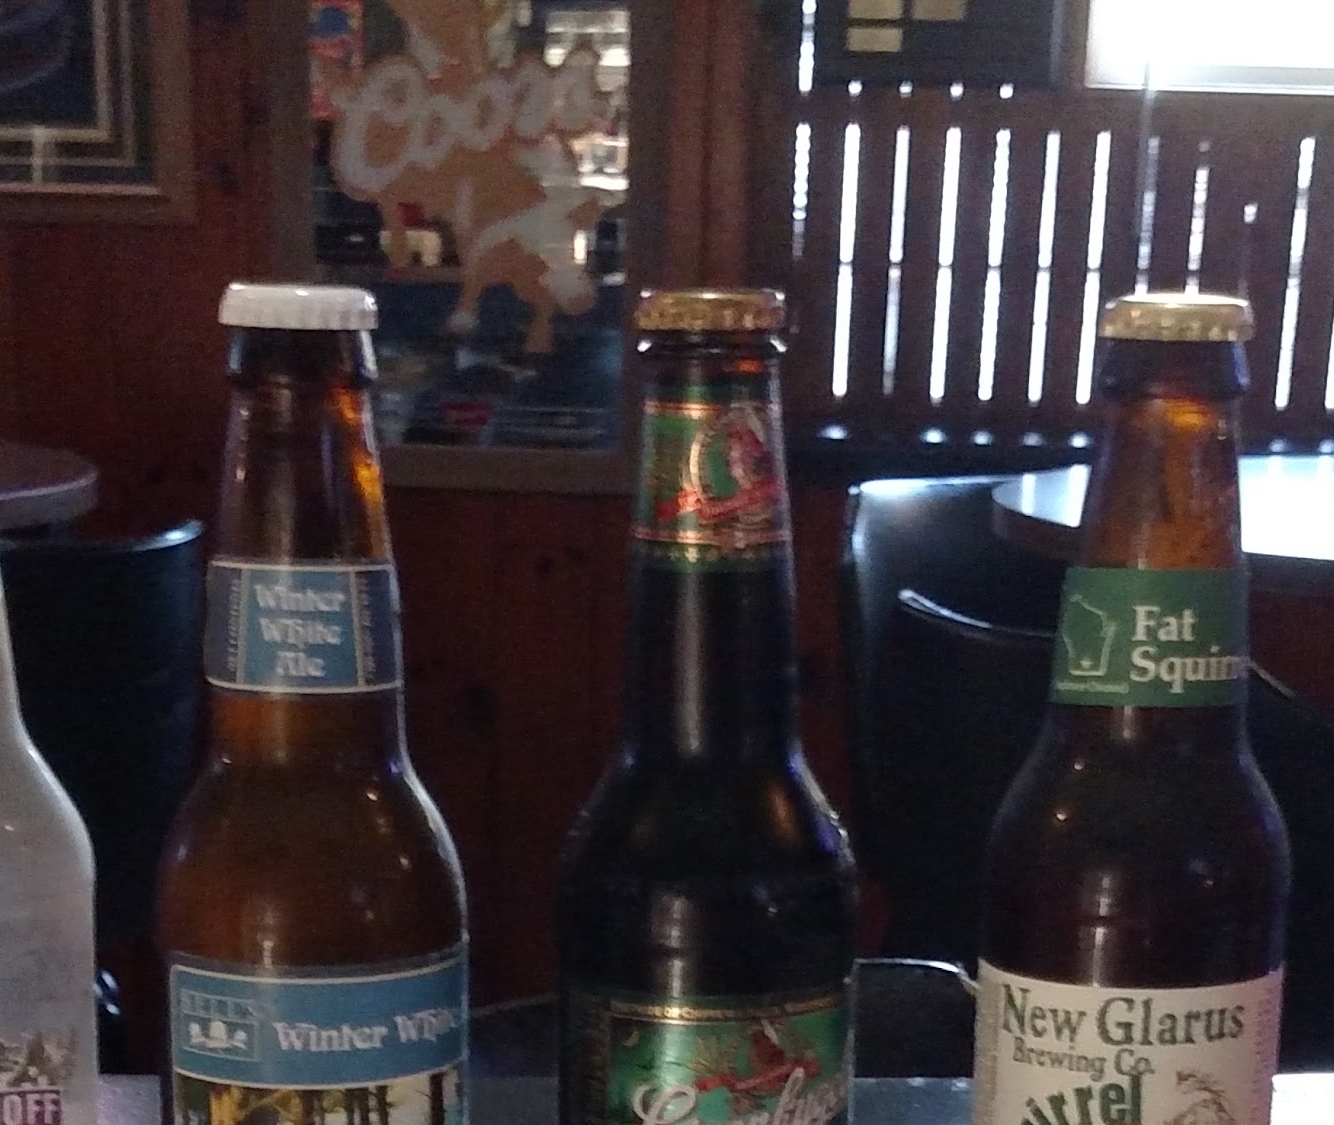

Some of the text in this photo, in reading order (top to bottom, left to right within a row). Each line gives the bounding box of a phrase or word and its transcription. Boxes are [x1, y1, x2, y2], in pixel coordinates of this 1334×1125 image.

[254, 583, 346, 613] Winter
[259, 616, 343, 649] White
[1131, 604, 1200, 642] Fat
[1001, 983, 1245, 1047] New Glarus
[272, 1020, 389, 1053] Winter
[1011, 1035, 1107, 1083] Brewing
